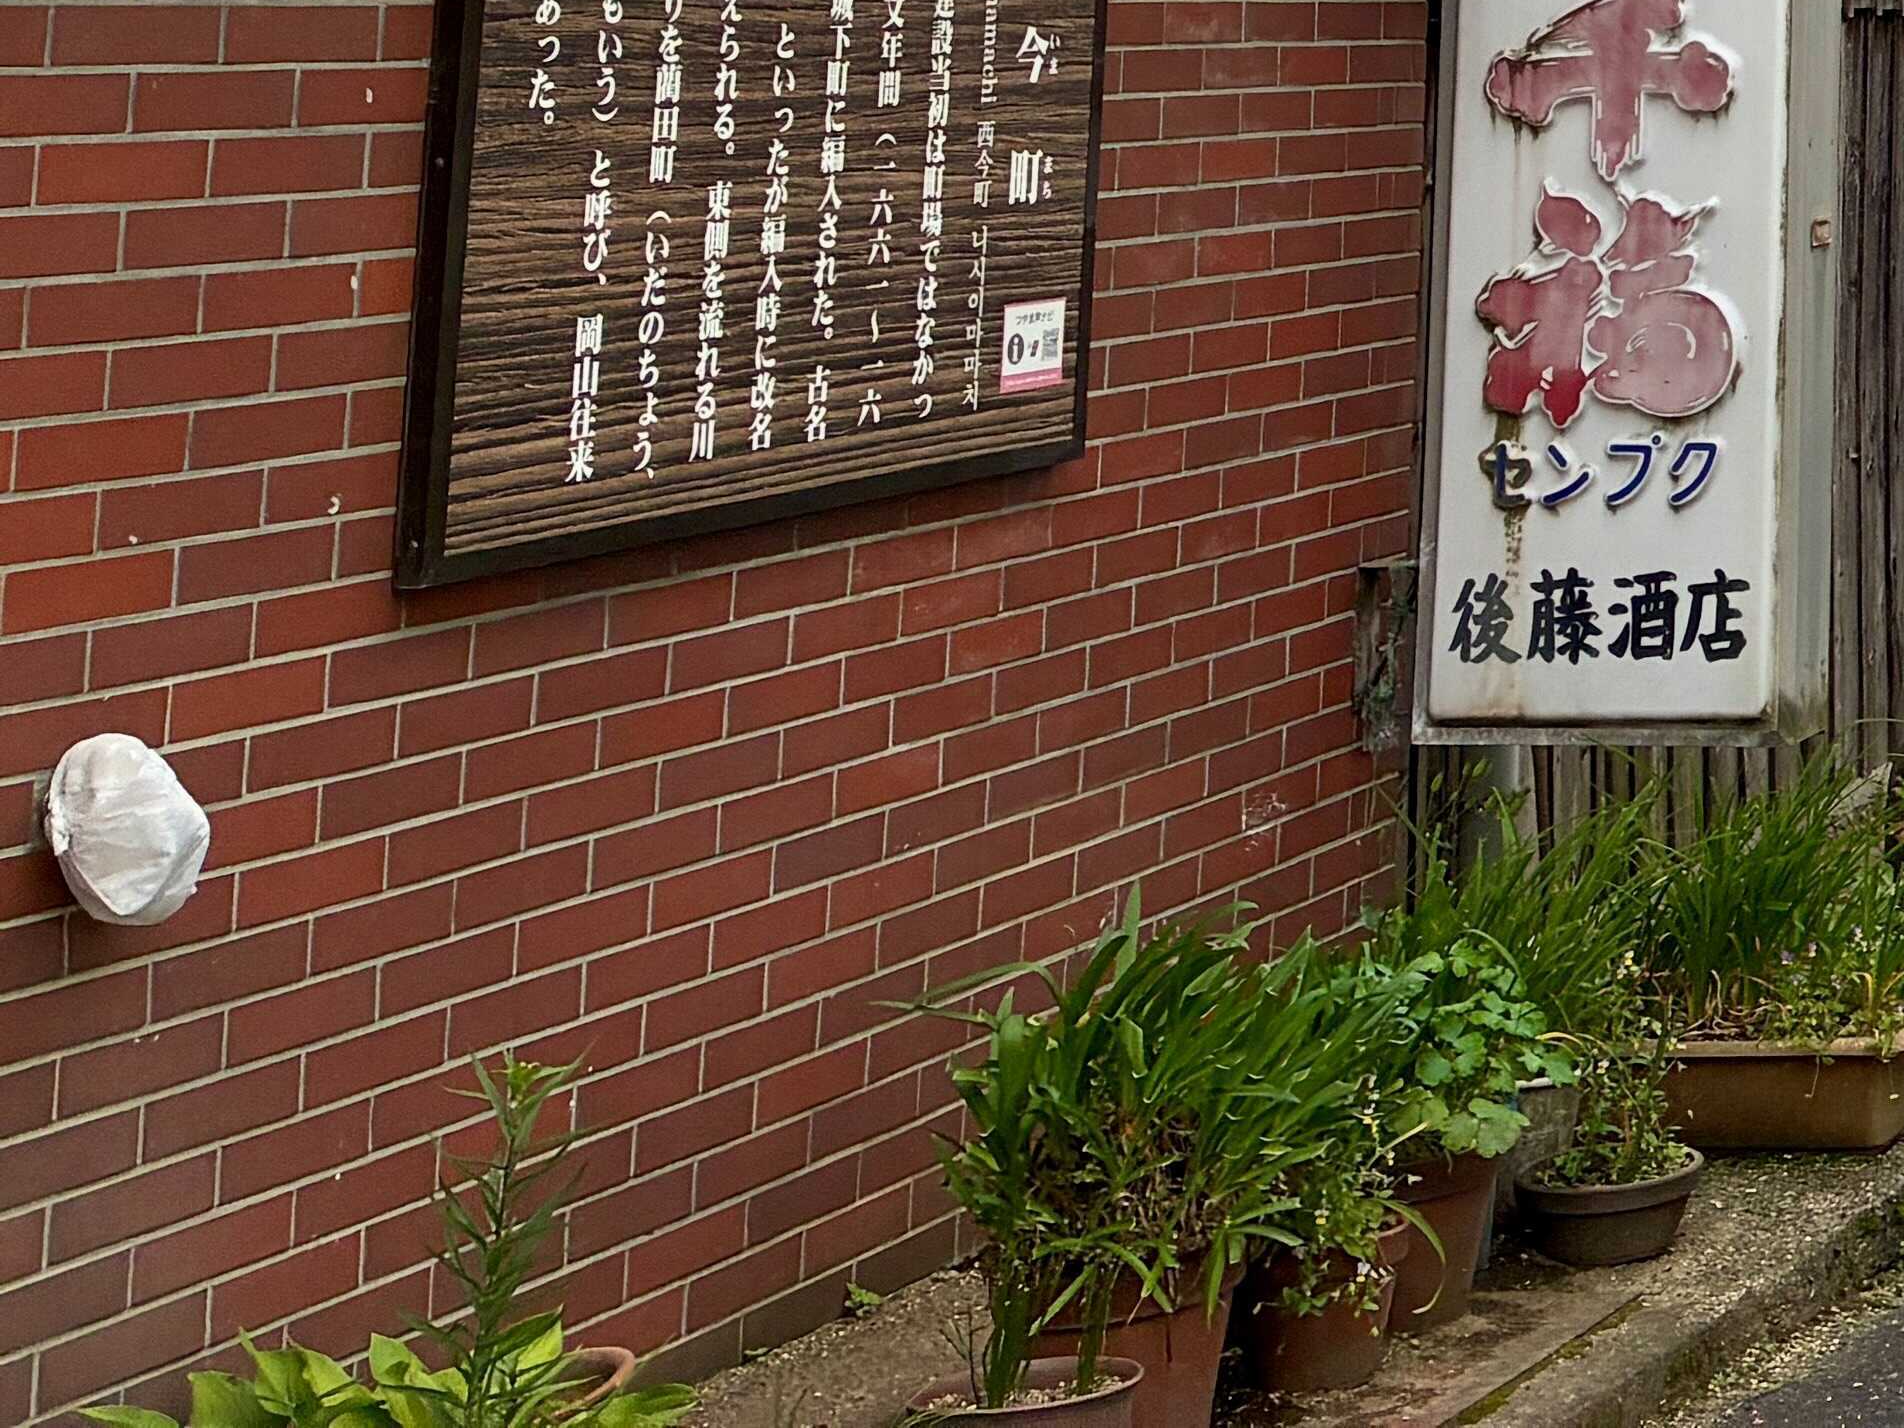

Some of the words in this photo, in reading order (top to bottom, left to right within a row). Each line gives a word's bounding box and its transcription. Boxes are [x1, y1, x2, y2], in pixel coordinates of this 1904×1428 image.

[973, 120, 996, 208] 西今町
[962, 225, 988, 411] 니시이마마치
[1481, 436, 1722, 508] センプク
[1448, 568, 1751, 665] 後藤酒店
